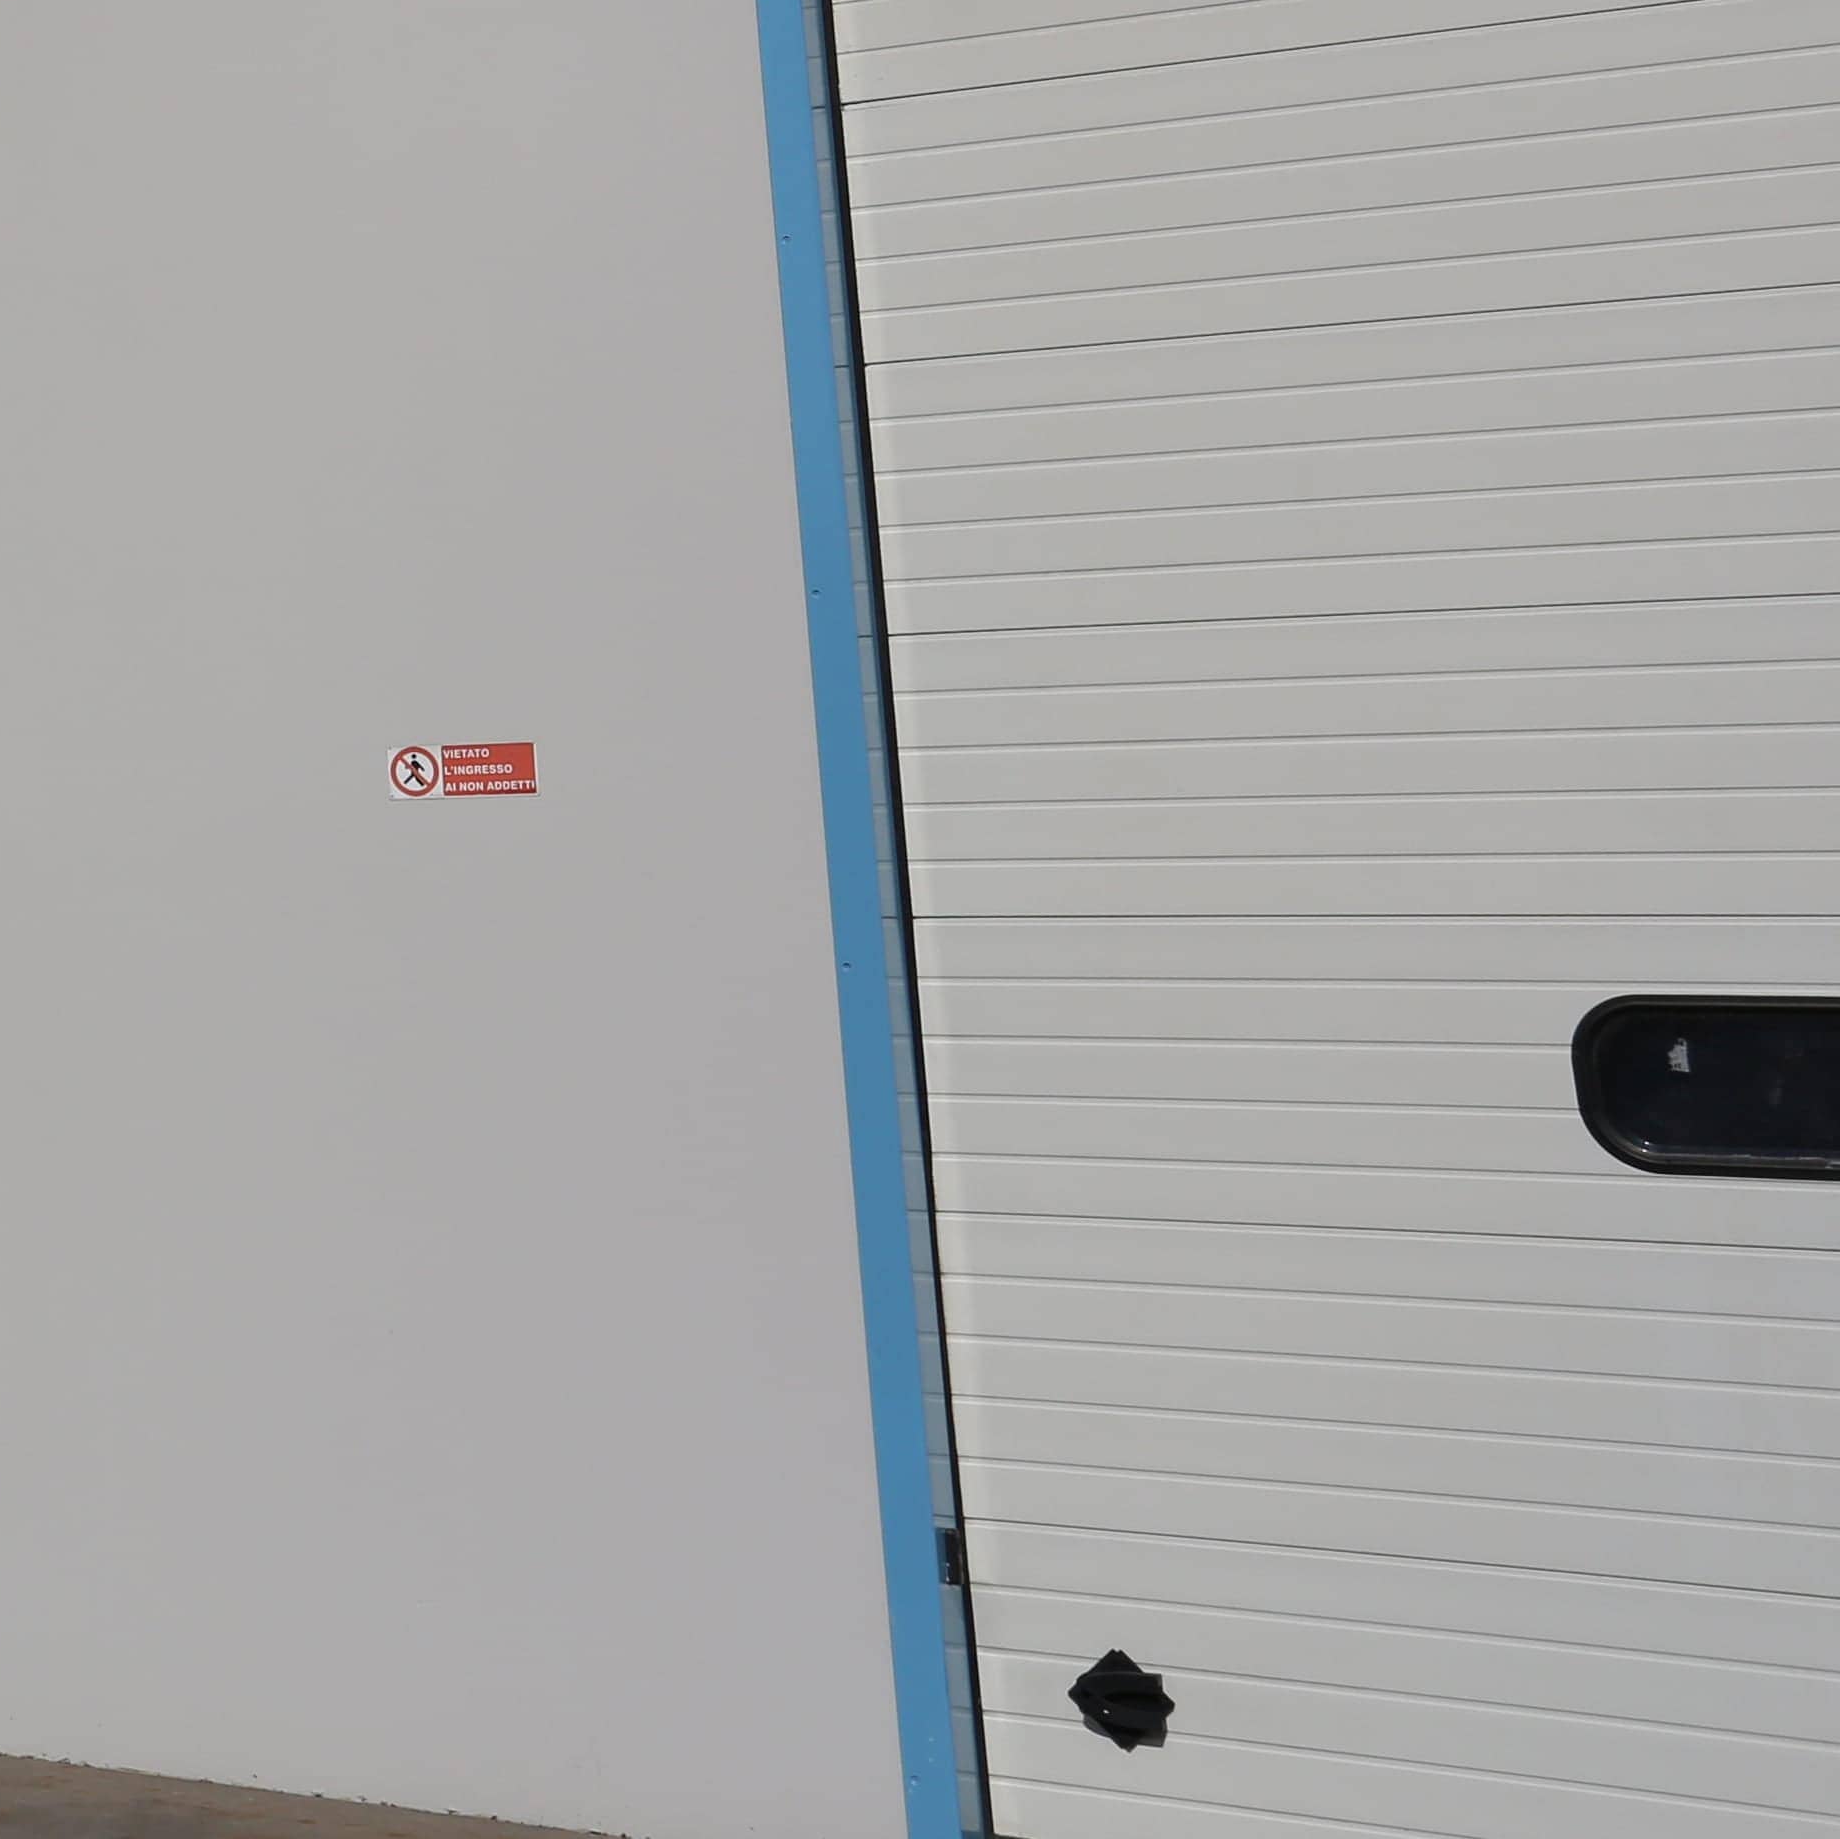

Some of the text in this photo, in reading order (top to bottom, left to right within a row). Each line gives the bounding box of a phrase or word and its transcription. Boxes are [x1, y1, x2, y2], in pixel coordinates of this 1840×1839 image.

[443, 747, 490, 759] VIETATO
[444, 763, 513, 776] L'INGRESSO
[445, 779, 535, 792] AI NON ADDETTI
